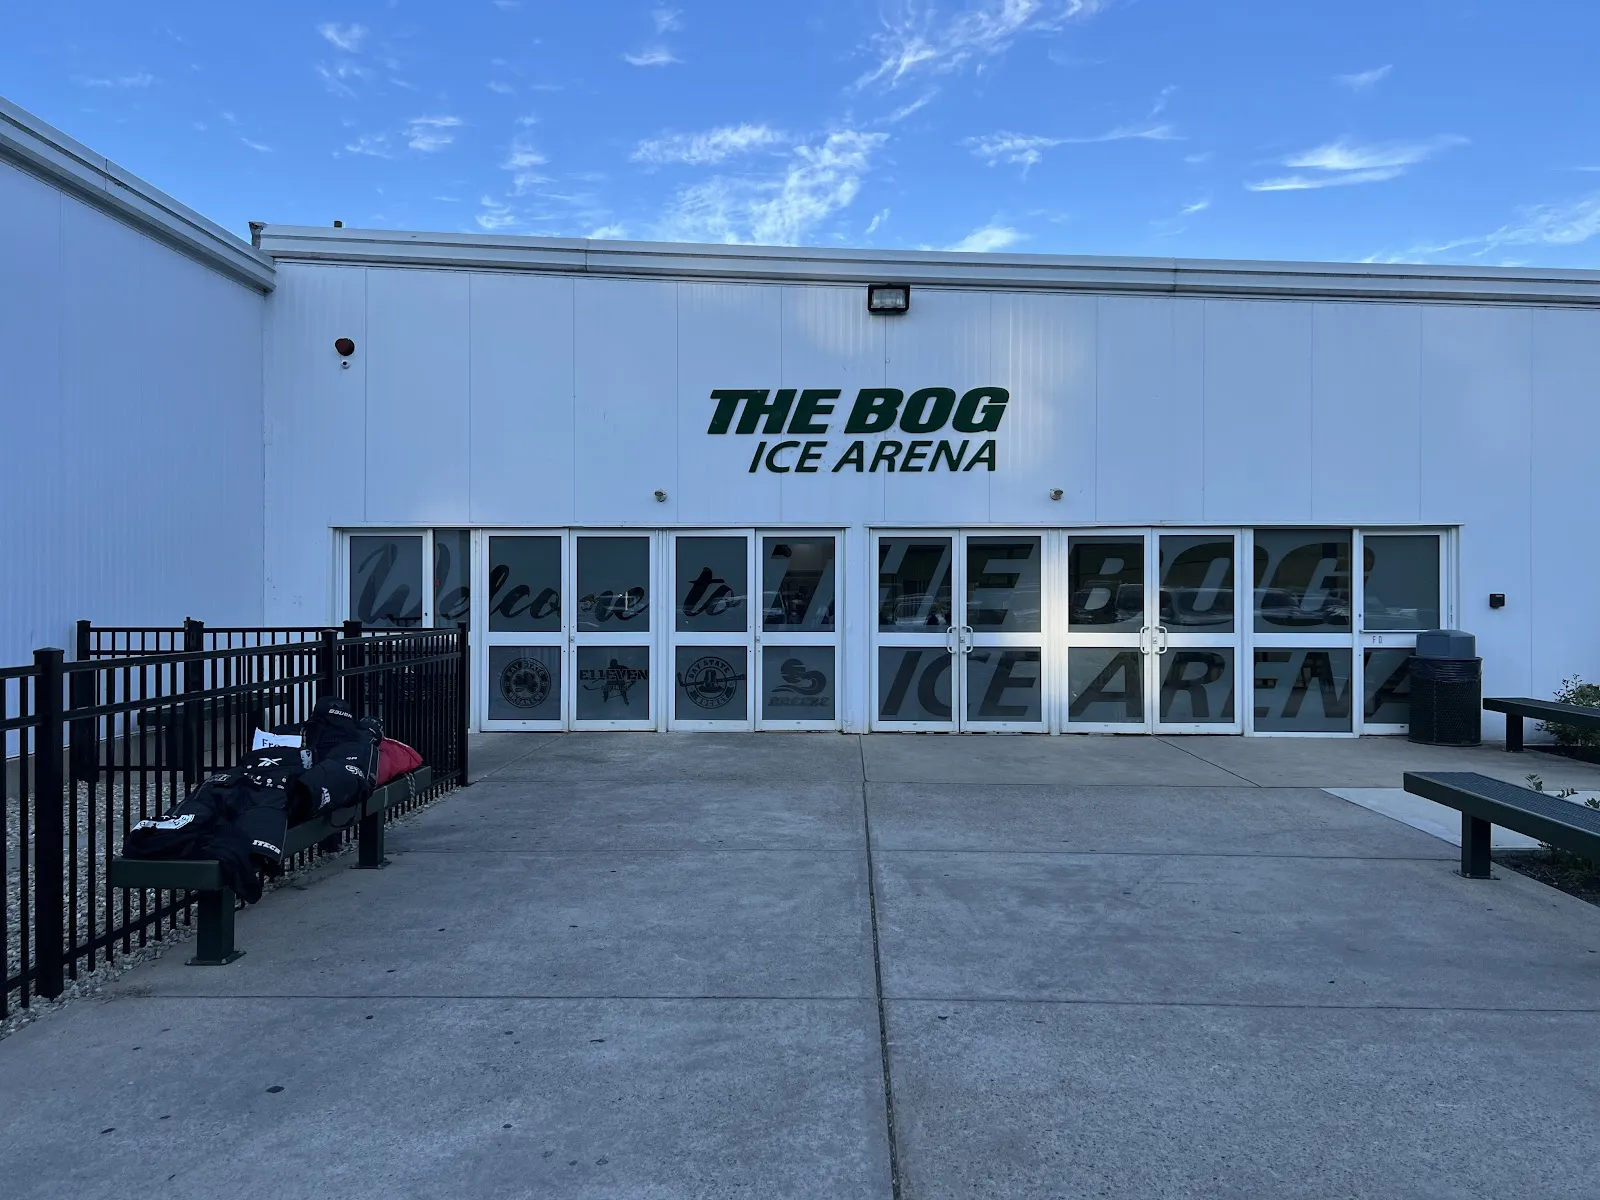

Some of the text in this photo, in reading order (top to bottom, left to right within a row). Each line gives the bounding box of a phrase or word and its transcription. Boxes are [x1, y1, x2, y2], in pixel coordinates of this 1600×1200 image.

[707, 386, 1010, 435] THE BOG
[748, 439, 996, 473] ICE ARENA
[683, 566, 746, 617] to
[1067, 542, 1376, 627] BOG
[703, 659, 731, 674] STATE
[880, 650, 1037, 717] ICE
